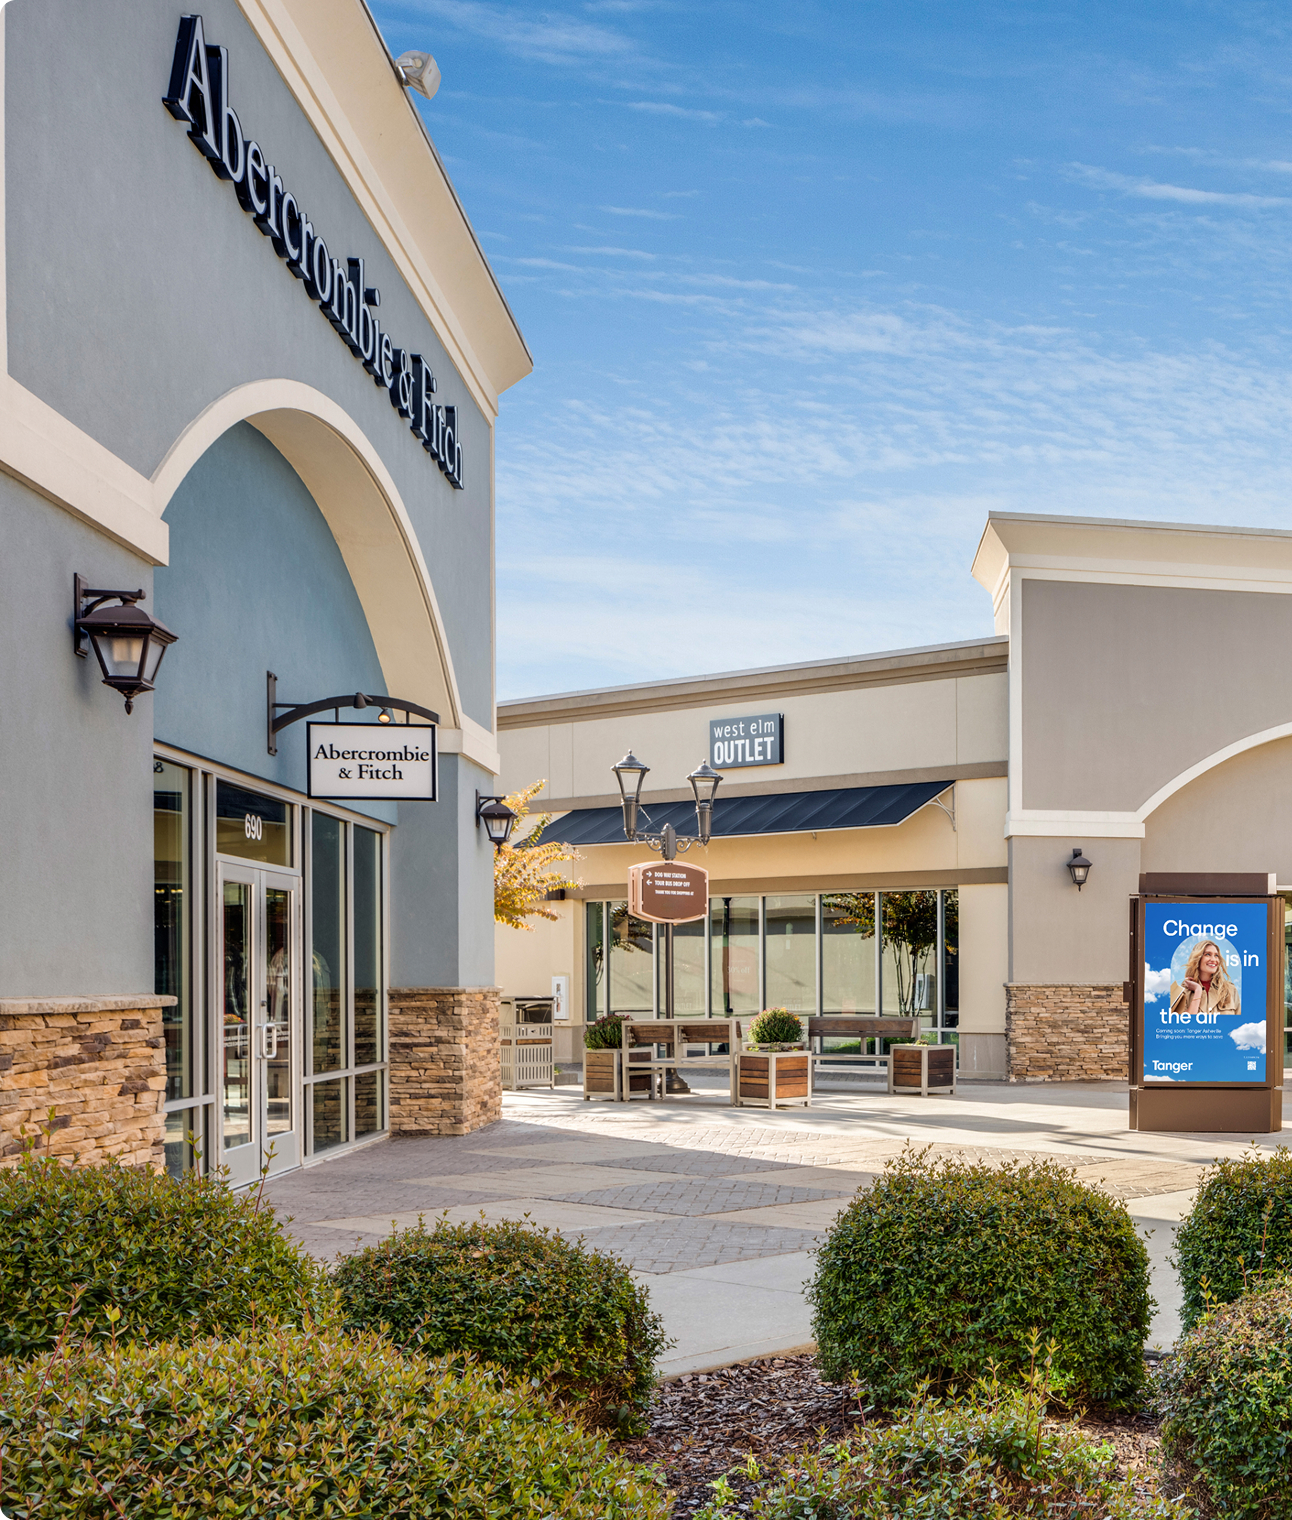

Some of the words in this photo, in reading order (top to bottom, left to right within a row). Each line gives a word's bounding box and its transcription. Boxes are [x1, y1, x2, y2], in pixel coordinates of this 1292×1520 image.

[163, 14, 394, 388] Abercrombie
[394, 349, 415, 419] &
[410, 354, 464, 490] Fitch
[714, 721, 745, 738] west
[750, 719, 774, 735] elm
[314, 743, 430, 761] Abercrombie
[714, 736, 774, 765] OUTLET
[338, 767, 352, 779] &
[357, 763, 403, 780] Fitch
[244, 813, 262, 841] 690
[1163, 919, 1238, 940] Change
[1226, 949, 1240, 967] is
[1243, 949, 1259, 967] in
[1160, 1007, 1191, 1024] the
[1196, 1007, 1220, 1024] air
[1152, 1060, 1193, 1074] Tanger
